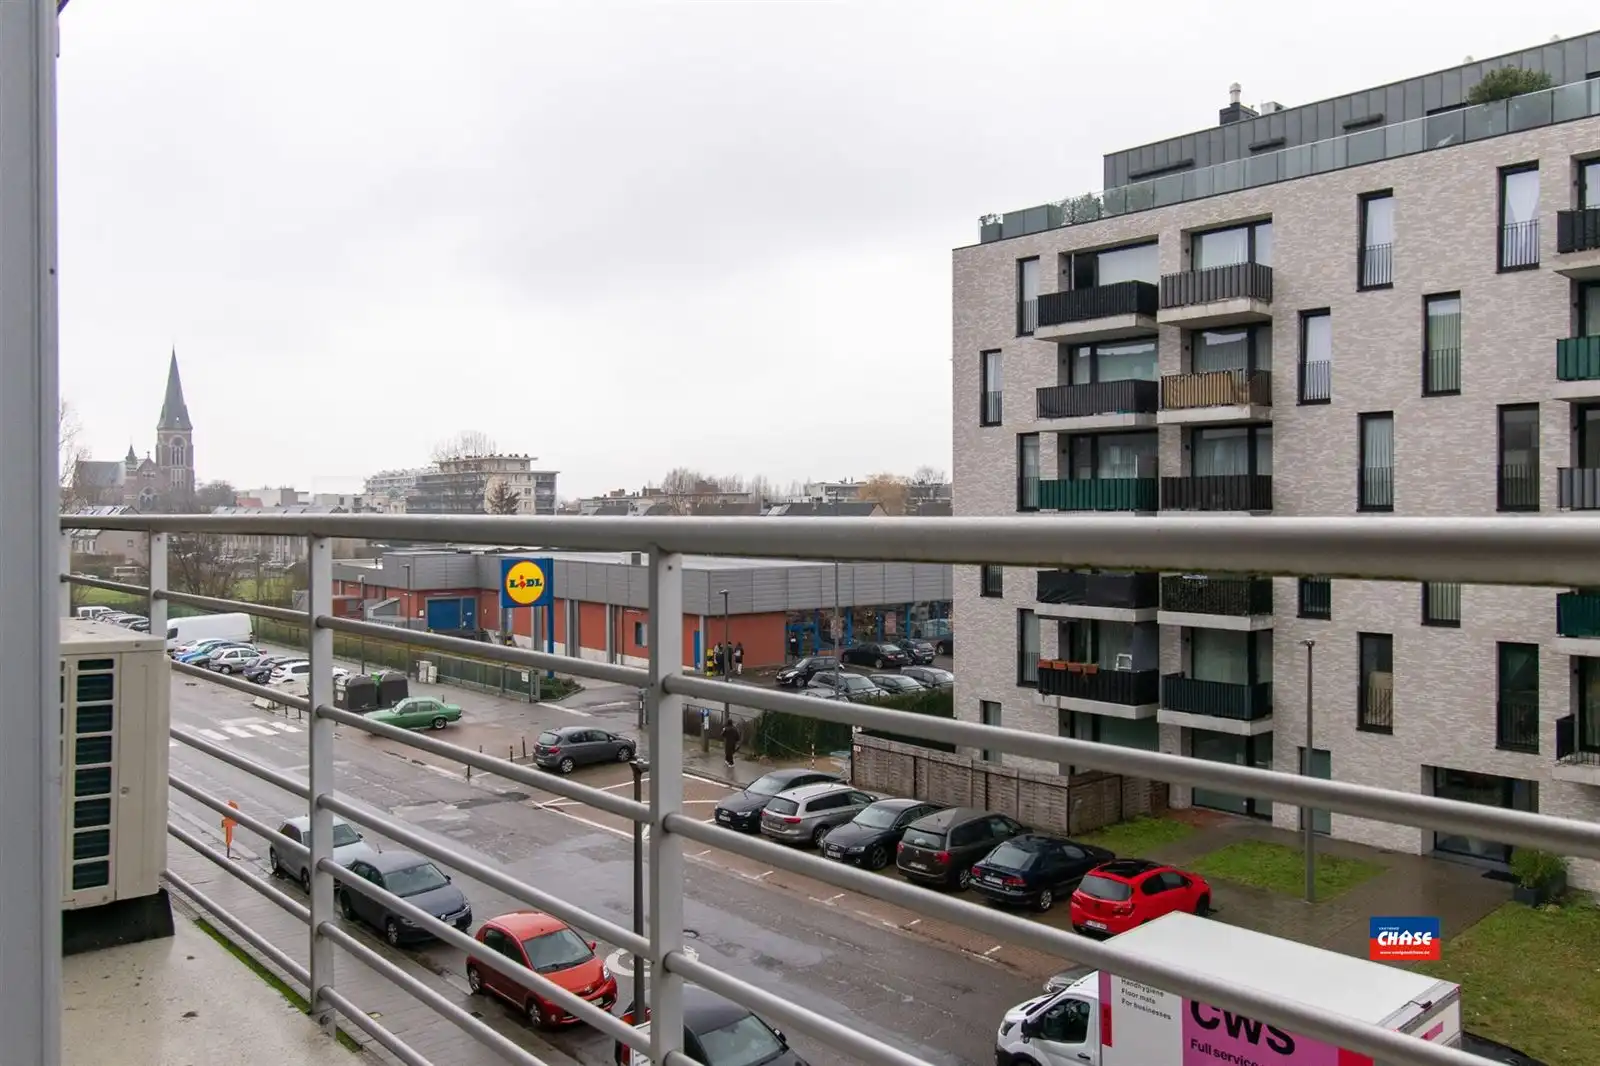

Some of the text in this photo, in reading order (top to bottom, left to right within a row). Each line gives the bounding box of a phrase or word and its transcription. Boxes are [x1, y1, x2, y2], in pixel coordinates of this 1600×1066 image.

[1121, 987, 1156, 1005] Floor mats
[1121, 997, 1172, 1020] For businesses
[1190, 1037, 1212, 1056] Full
